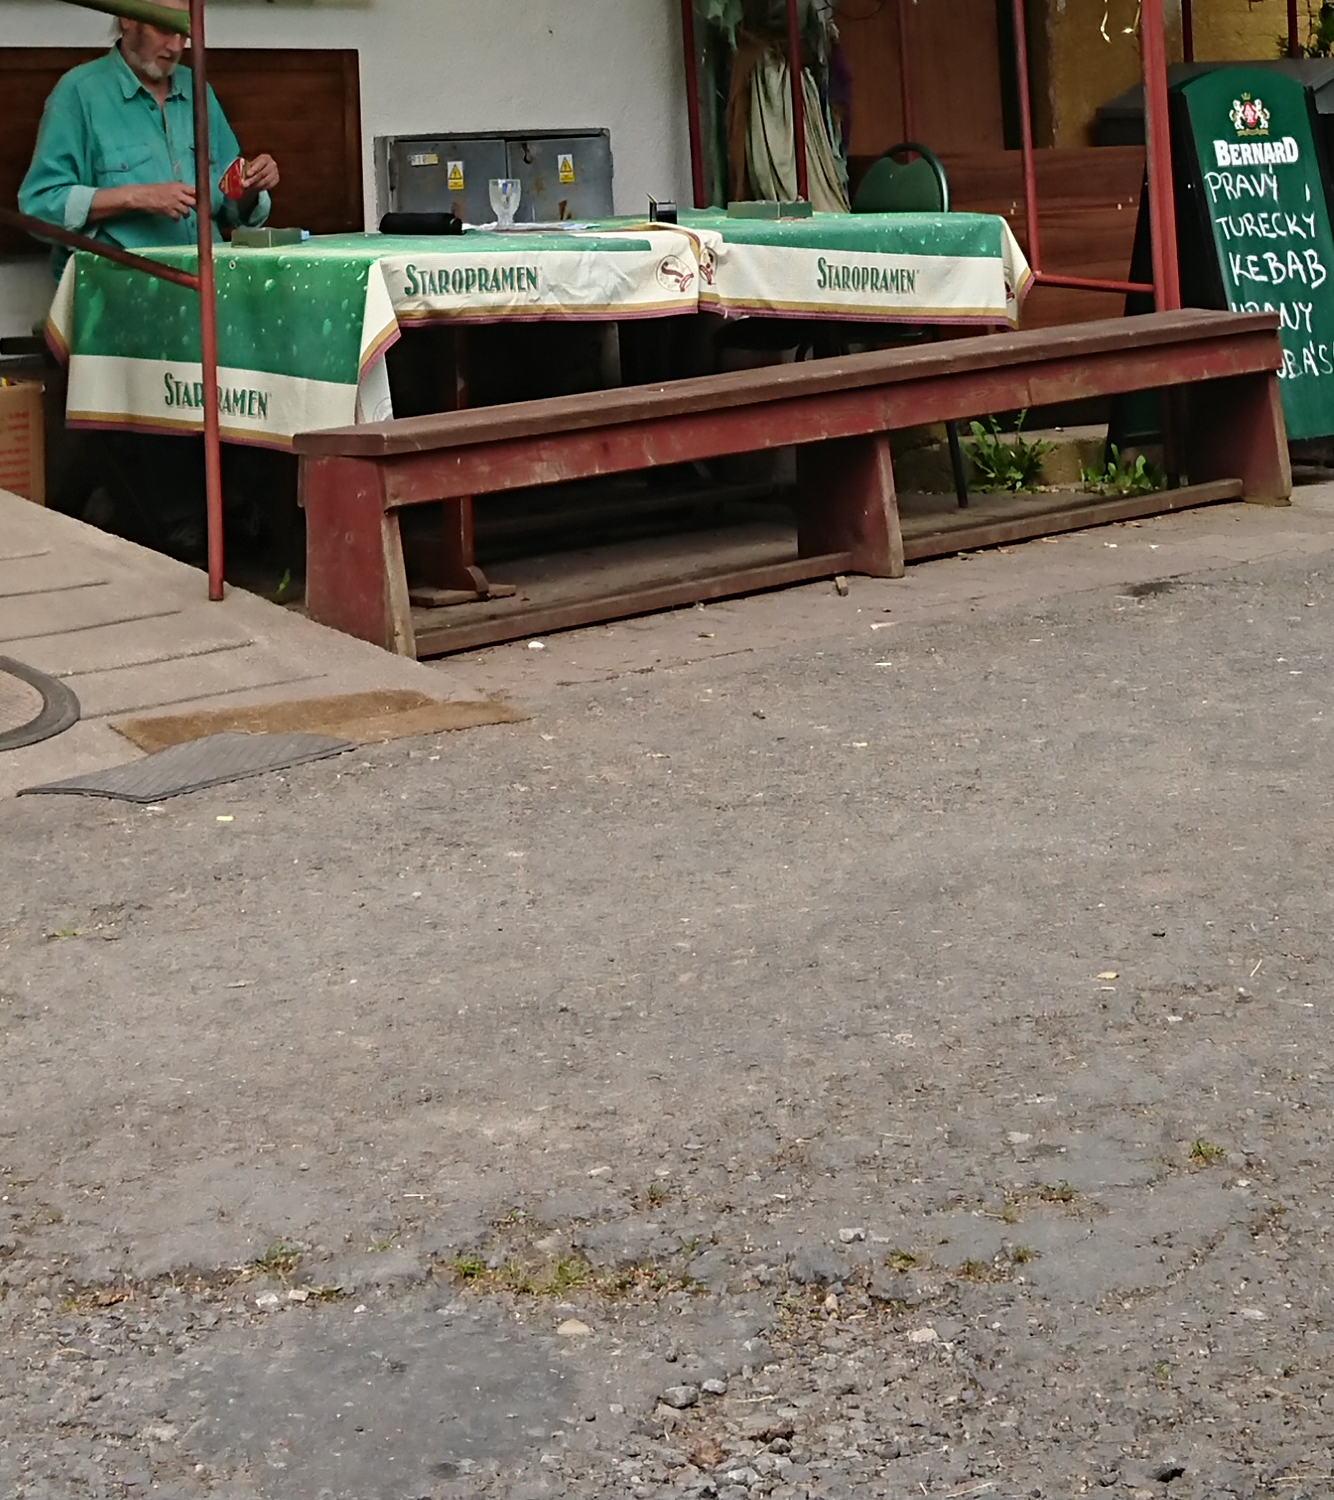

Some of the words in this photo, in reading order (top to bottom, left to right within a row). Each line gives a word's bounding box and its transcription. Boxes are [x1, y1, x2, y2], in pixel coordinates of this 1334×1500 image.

[1213, 136, 1299, 167] BERNARD
[1204, 162, 1279, 203] PRAVÝ
[404, 264, 538, 297] STAROPRAMEN
[817, 257, 916, 294] STAROPRAMEN
[1228, 249, 1327, 289] KEBAB
[164, 372, 268, 419] STARRAMEN
